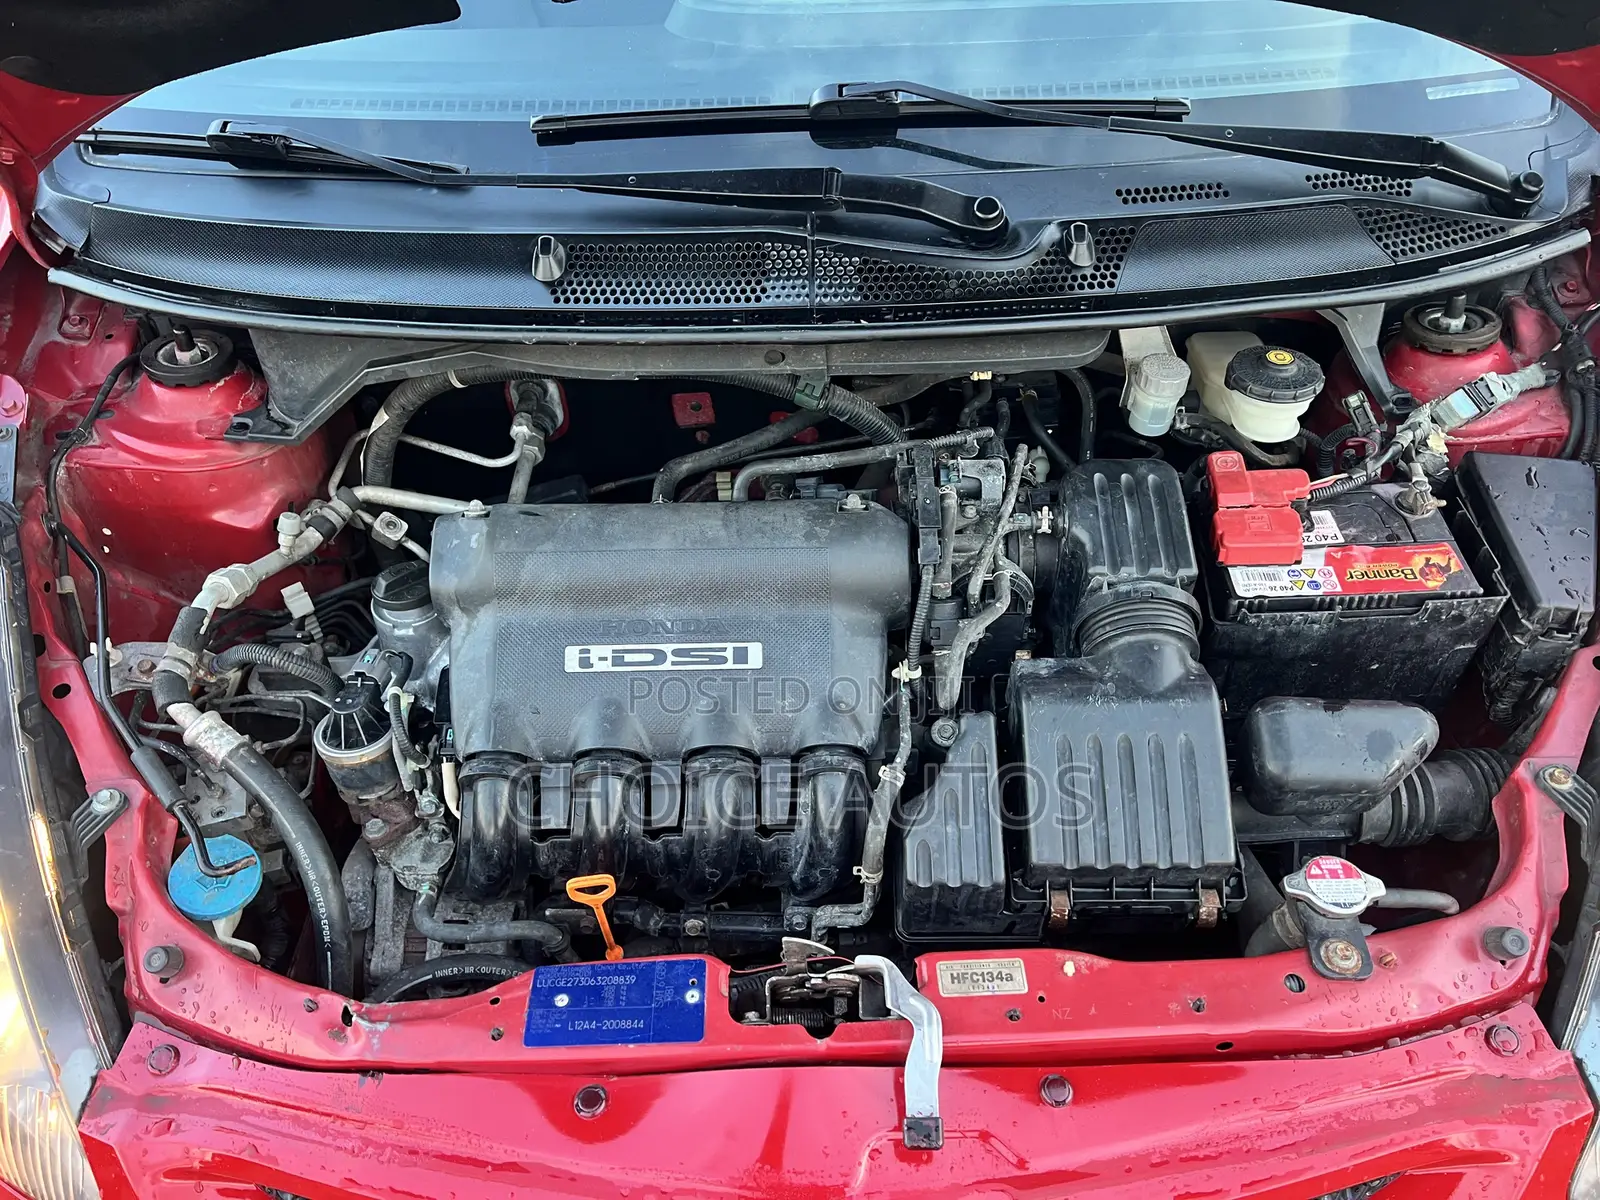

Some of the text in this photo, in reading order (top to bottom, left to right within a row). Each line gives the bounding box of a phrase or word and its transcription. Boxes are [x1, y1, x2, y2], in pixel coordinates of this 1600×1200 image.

[1314, 533, 1339, 542] P40
[1345, 567, 1418, 582] Banner
[599, 619, 731, 637] HONDA
[949, 970, 1014, 985] HFC134a
[568, 1019, 644, 1031] L12A4-2008844
